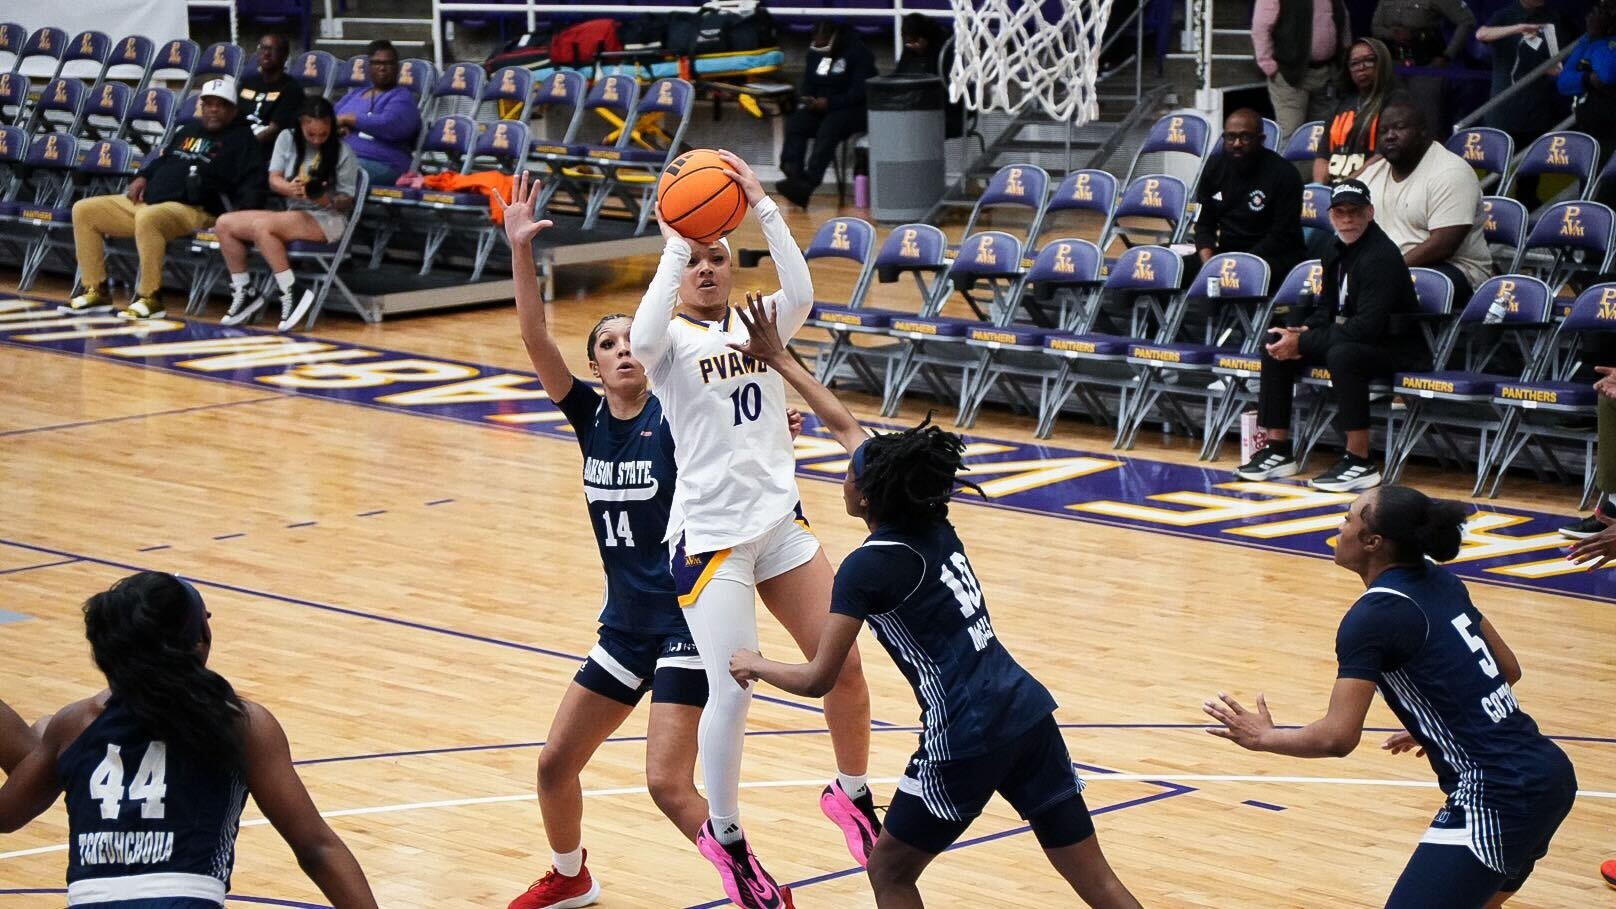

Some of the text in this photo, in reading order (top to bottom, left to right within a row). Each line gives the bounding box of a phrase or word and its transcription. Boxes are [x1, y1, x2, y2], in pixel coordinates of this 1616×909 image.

[894, 320, 937, 335] PANTHERS
[972, 330, 1016, 344] PANTHERS
[1051, 338, 1095, 353] PANTHERS
[1134, 347, 1180, 362] PANTHERS
[1220, 358, 1262, 371] PANTHER
[1403, 377, 1454, 393] PANTHERS
[1502, 387, 1557, 403] PANTHERS
[730, 382, 762, 427] 10
[617, 460, 652, 485] STATE
[603, 510, 635, 547] 14
[940, 551, 981, 619] 10
[1451, 612, 1500, 679] 5
[90, 741, 167, 820] 44
